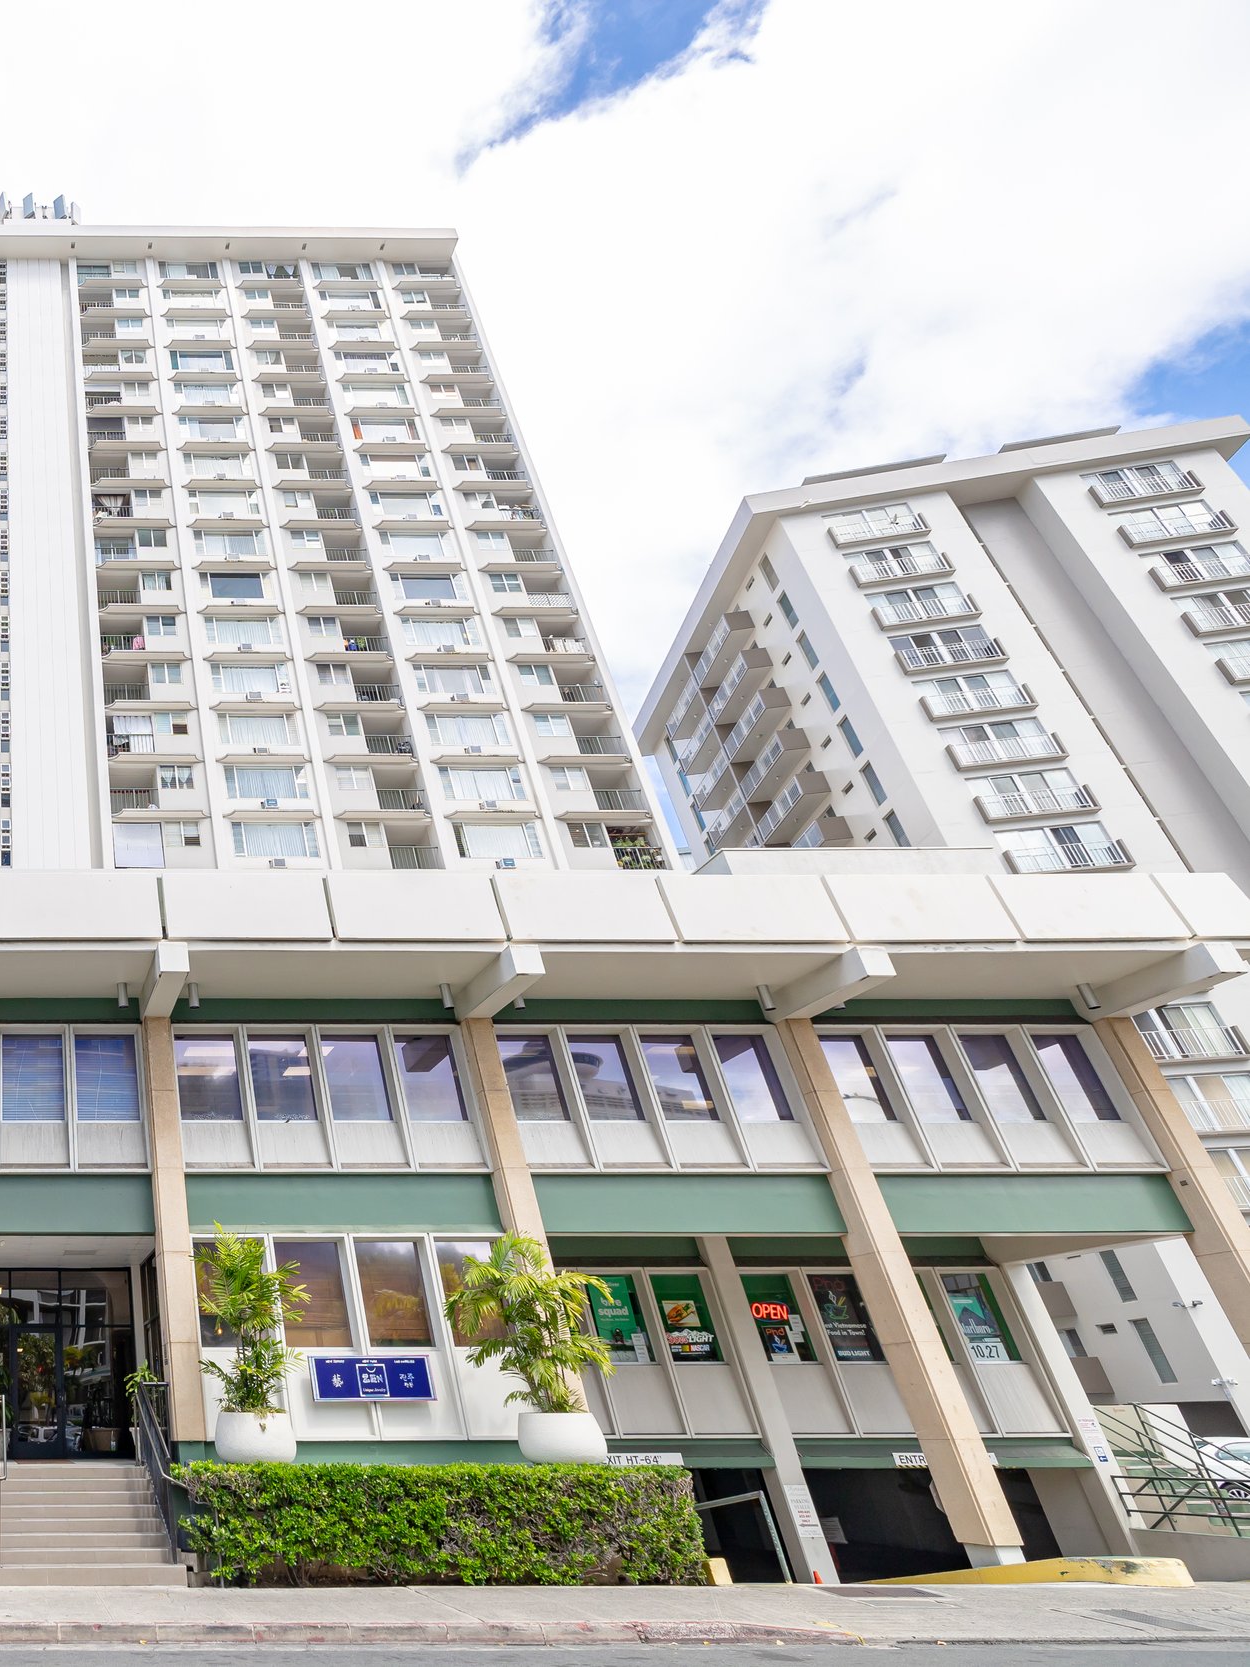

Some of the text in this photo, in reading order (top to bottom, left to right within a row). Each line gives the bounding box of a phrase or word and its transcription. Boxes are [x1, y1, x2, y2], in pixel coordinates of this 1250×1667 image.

[598, 1306, 629, 1317] squad
[752, 1303, 788, 1320] OPEN
[689, 1334, 714, 1343] LIGHT
[971, 1344, 1000, 1358] 10.27
[601, 1455, 621, 1465] XIT
[898, 1455, 927, 1464] ENTR
